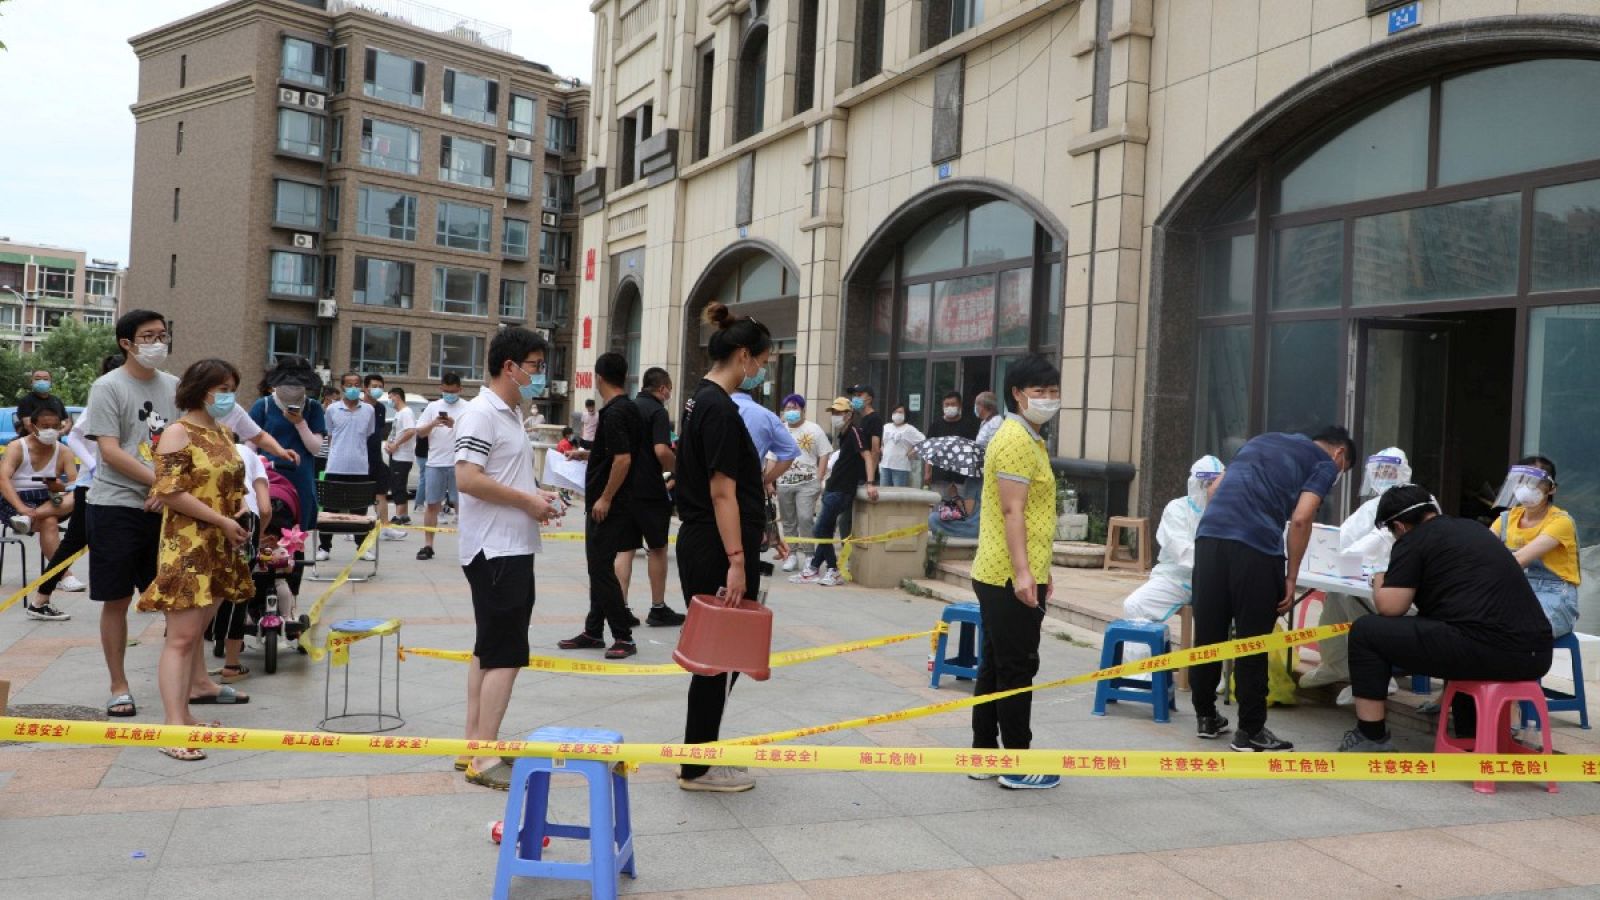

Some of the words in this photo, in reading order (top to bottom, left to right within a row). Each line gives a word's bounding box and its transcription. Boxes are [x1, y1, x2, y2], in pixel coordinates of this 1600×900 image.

[860, 752, 923, 766] 施工危险!
[955, 754, 1020, 768] 注意安全!
[1062, 756, 1127, 770] 施工危险!
[1160, 757, 1225, 772] 注意安全!
[1268, 759, 1335, 773] 施工危险!
[1368, 759, 1436, 774] 注意安全!
[1479, 760, 1548, 775] 施工危险!
